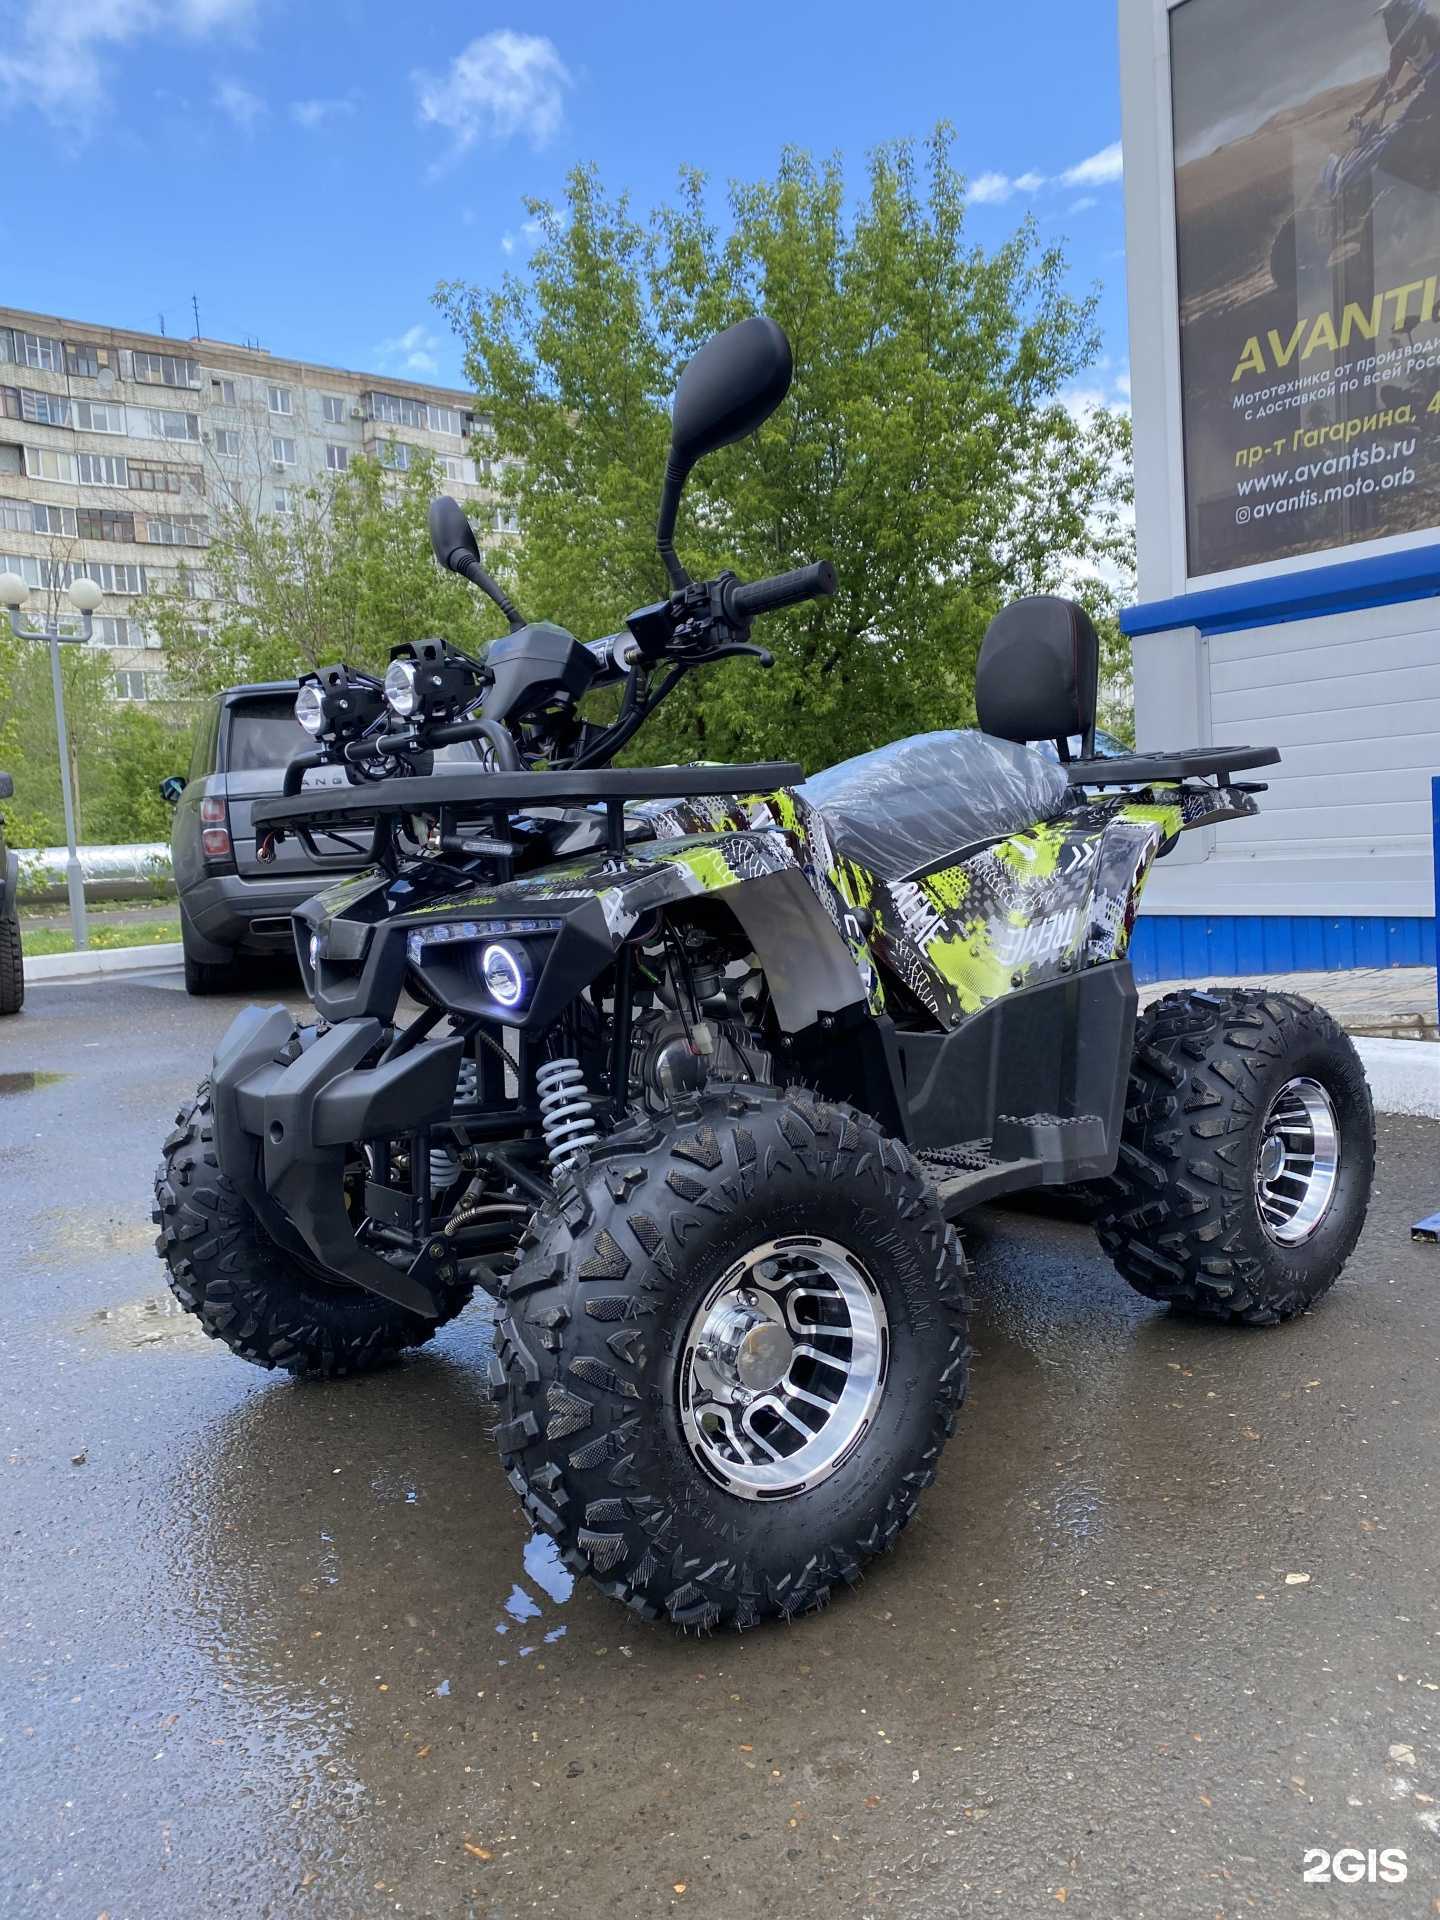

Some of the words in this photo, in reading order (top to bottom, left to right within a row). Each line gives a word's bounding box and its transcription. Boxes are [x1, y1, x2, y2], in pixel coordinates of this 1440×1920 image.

[1231, 275, 1440, 384] AVANTI
[1232, 369, 1331, 410] Мототехника
[1334, 363, 1353, 378] от
[1244, 410, 1253, 421] с
[1256, 381, 1336, 419] доставкой
[1340, 379, 1359, 394] по
[1363, 362, 1402, 387] всей
[1234, 438, 1287, 469] пр-т
[1292, 404, 1417, 452] Гагарина,
[1237, 437, 1417, 497] www.avantsb.ru
[1252, 465, 1416, 519] avantis.moto.orb
